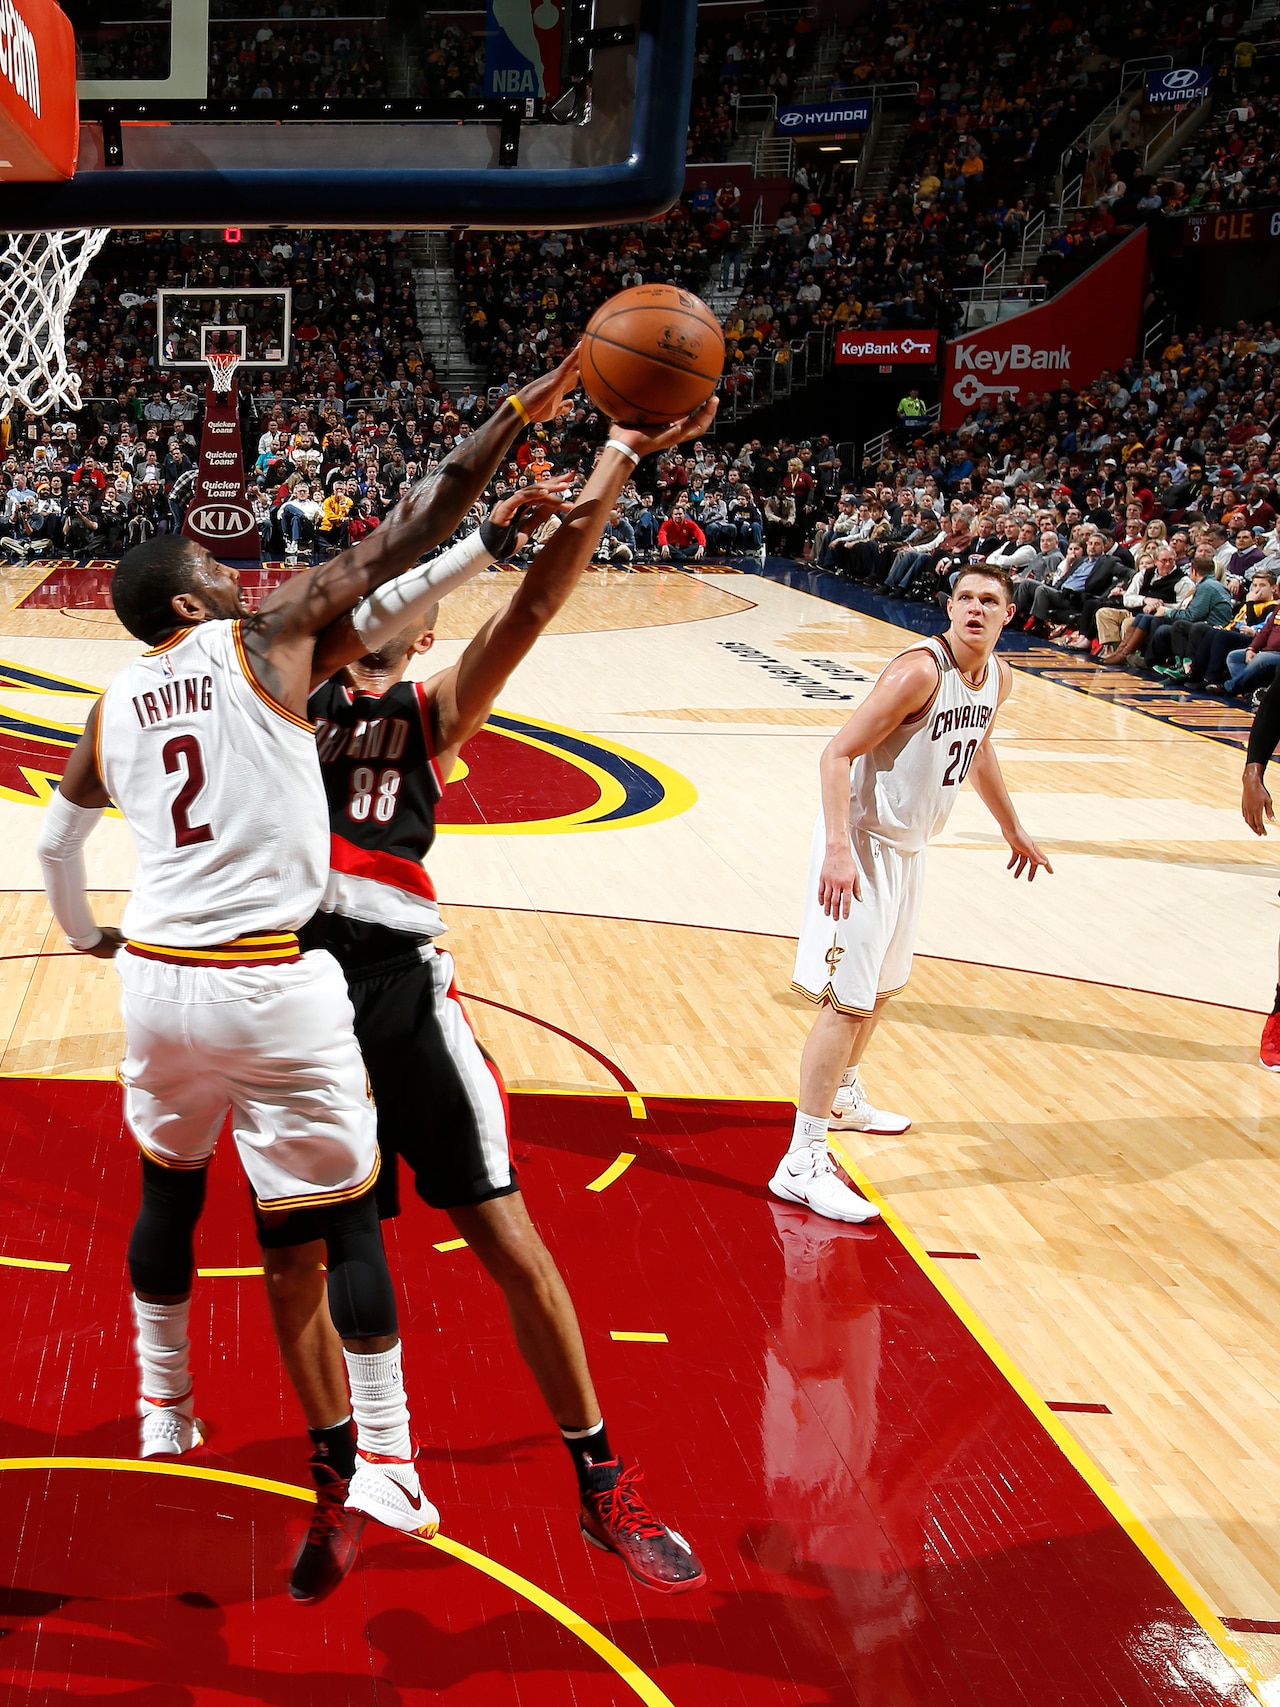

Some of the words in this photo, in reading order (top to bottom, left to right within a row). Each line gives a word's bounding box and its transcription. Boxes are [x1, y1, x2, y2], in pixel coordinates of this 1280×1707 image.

[492, 69, 535, 93] NBA
[805, 109, 867, 124] HYUNDAI
[1192, 226, 1201, 242] 3
[1214, 213, 1253, 240] CLE
[841, 342, 898, 357] KeyBank
[954, 345, 1071, 374] KeyBank
[208, 421, 236, 429] Quicken
[205, 451, 238, 459] Quicken
[209, 457, 235, 466] Loans
[201, 480, 240, 490] Quicken
[207, 488, 237, 498] Loans
[199, 511, 243, 530] KIA
[132, 675, 213, 729] IRVING
[942, 738, 978, 787] 20
[162, 734, 214, 849] 2
[347, 766, 401, 824] 88
